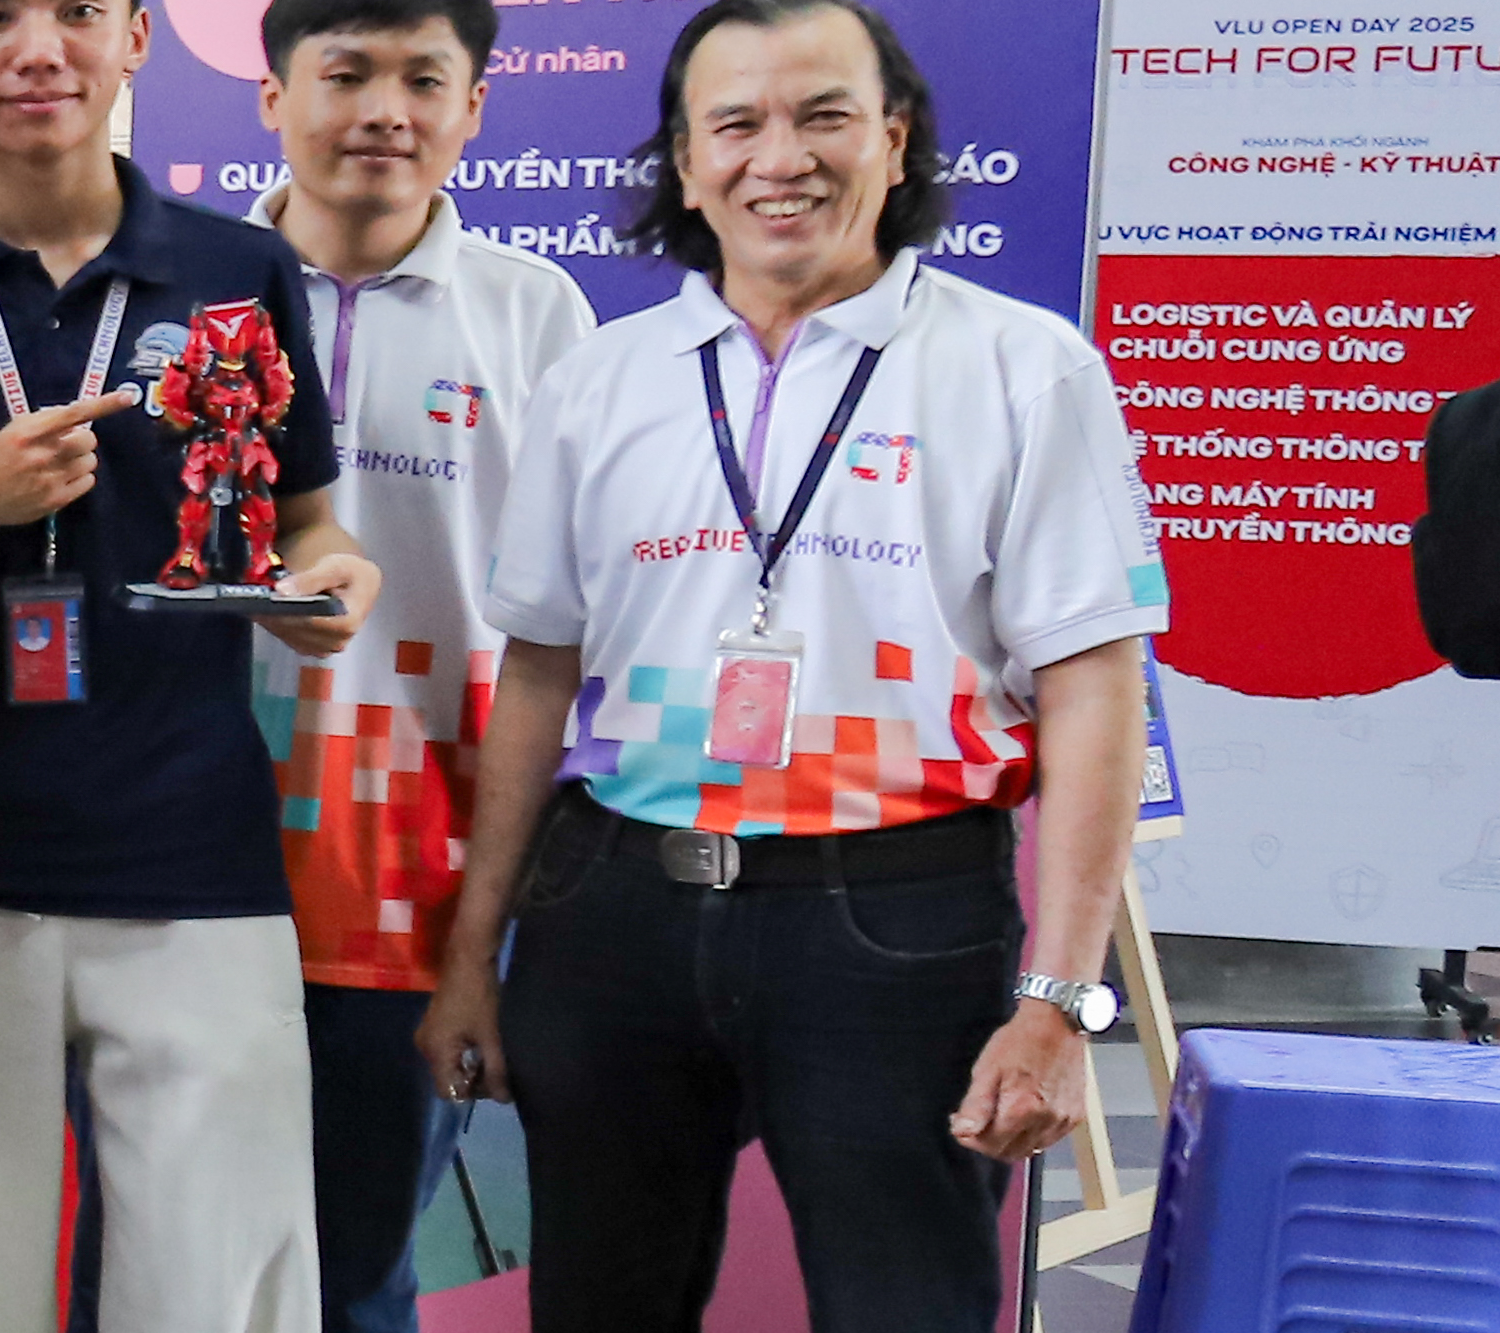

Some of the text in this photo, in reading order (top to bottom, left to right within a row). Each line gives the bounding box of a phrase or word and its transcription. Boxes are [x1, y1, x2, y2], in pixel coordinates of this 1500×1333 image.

[1214, 16, 1476, 35] VLU OPEN DAY 2025
[535, 46, 625, 73] nhân
[1110, 47, 1357, 74] TECH FOR
[1168, 152, 1500, 178] CÔNG NGHỆ KỸ THUẬT
[1115, 223, 1171, 243] VỰC
[1177, 225, 1245, 246] HOẠT
[1250, 221, 1323, 246] ĐỘNG
[1328, 220, 1387, 242] TRẢI
[1394, 222, 1497, 246] NGHIỆM
[1111, 299, 1474, 330] LOGISTIC VÀ QUẢN LÝ
[1109, 329, 1406, 363] CHUỖI CUNG ỨNG
[1114, 381, 1434, 415] CÔNG NGHỆ THÔNG
[1153, 428, 1273, 458] THỐNG
[1276, 433, 1399, 462] THÔNG
[1211, 481, 1375, 510] MÁY TÍNH
[1151, 513, 1413, 545] TRUYỀN THÔNG
